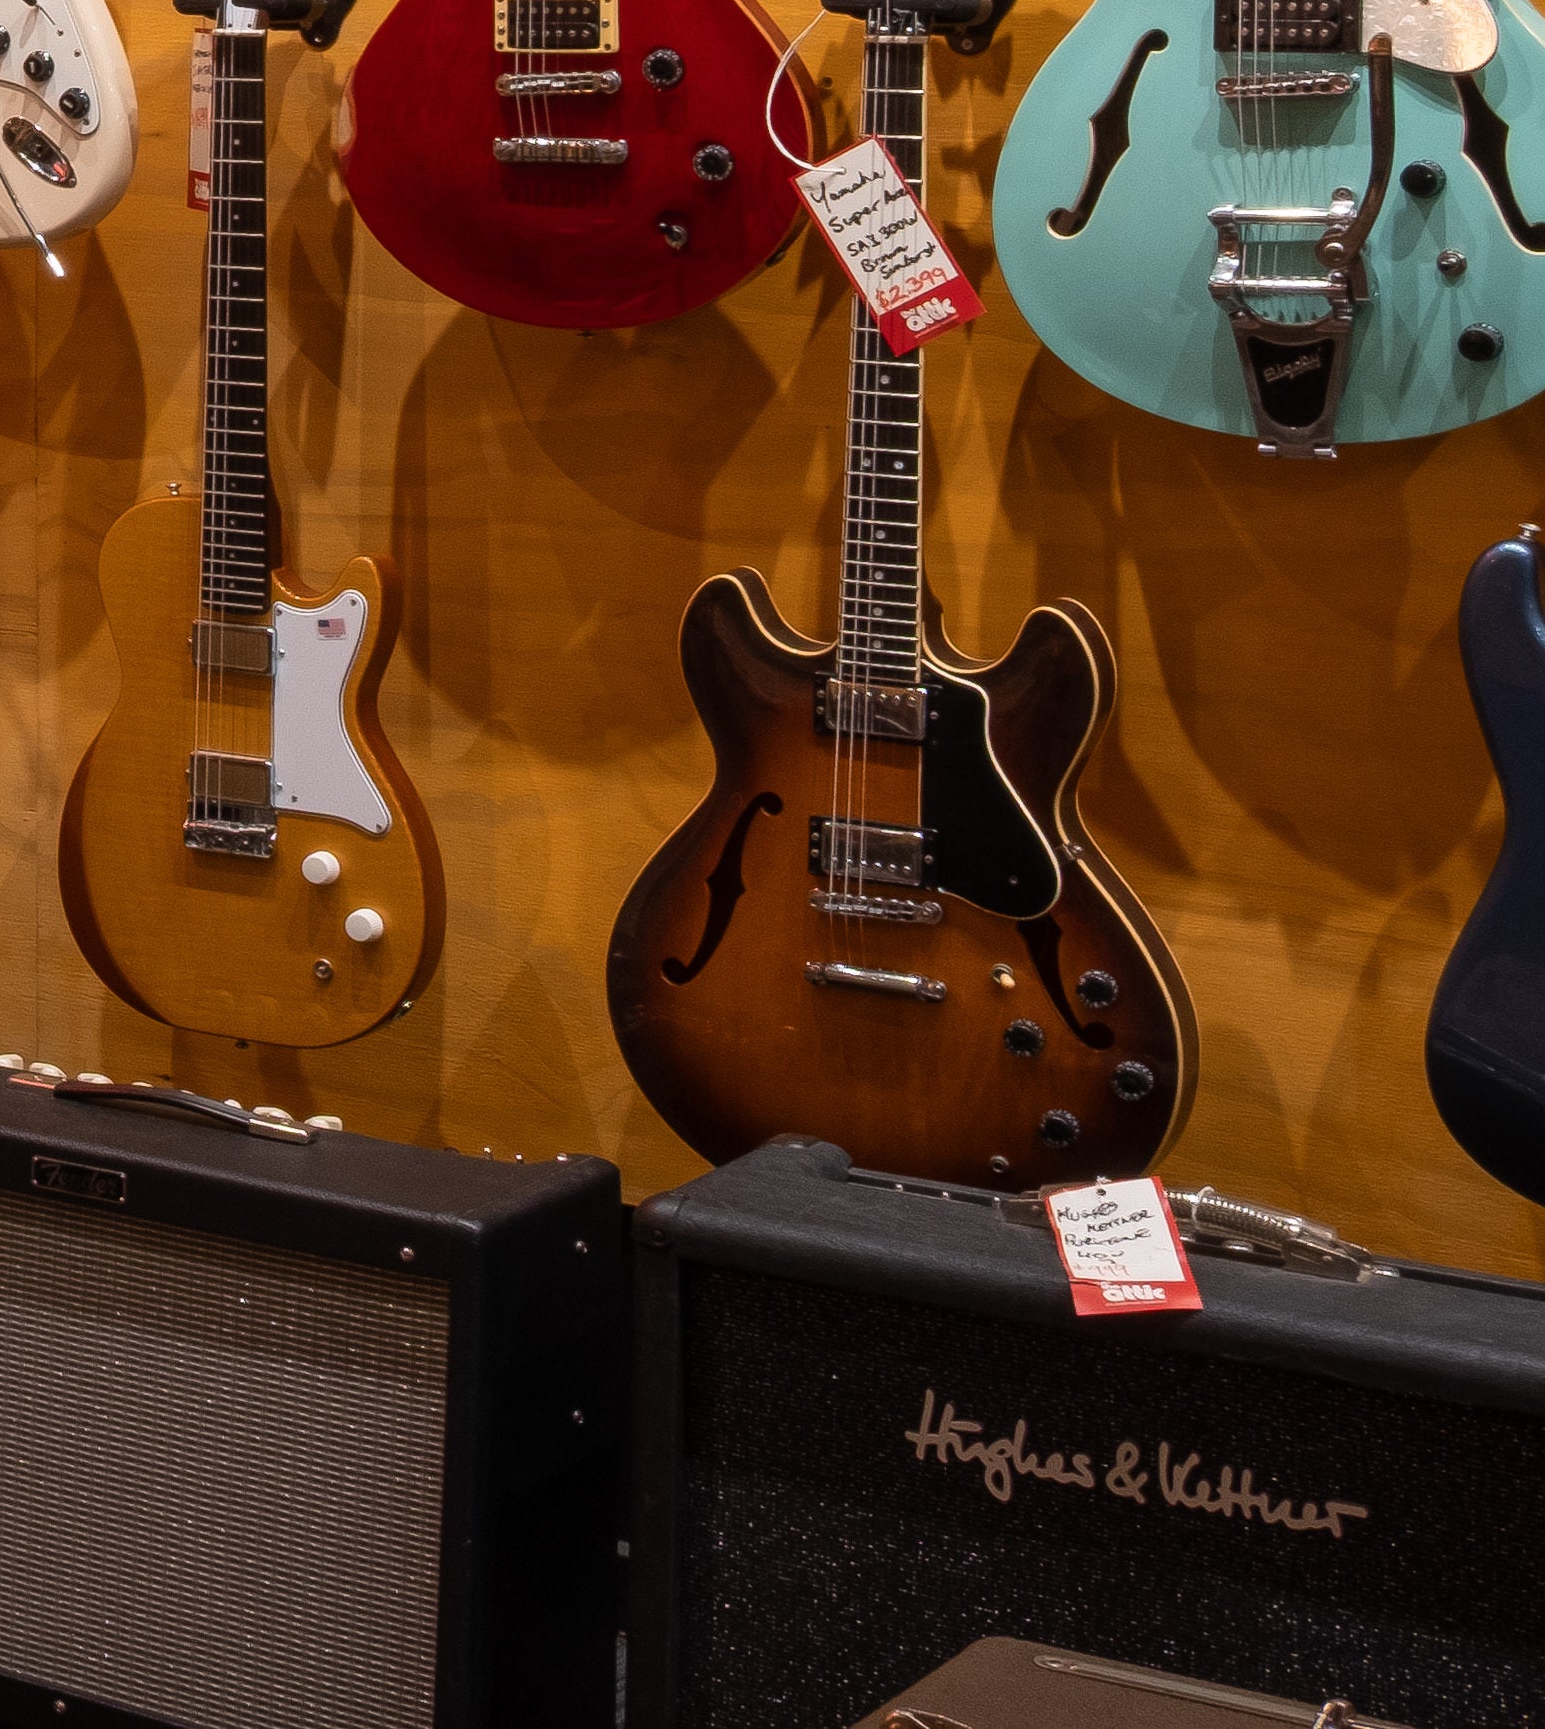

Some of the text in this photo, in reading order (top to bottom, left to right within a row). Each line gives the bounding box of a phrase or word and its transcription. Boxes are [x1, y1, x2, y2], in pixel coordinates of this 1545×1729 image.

[809, 168, 888, 214] Yamaha
[827, 199, 881, 234] Super
[900, 297, 958, 332] attic
[1101, 1282, 1167, 1304] attic
[905, 1389, 1368, 1539] Hughes & Kettner
